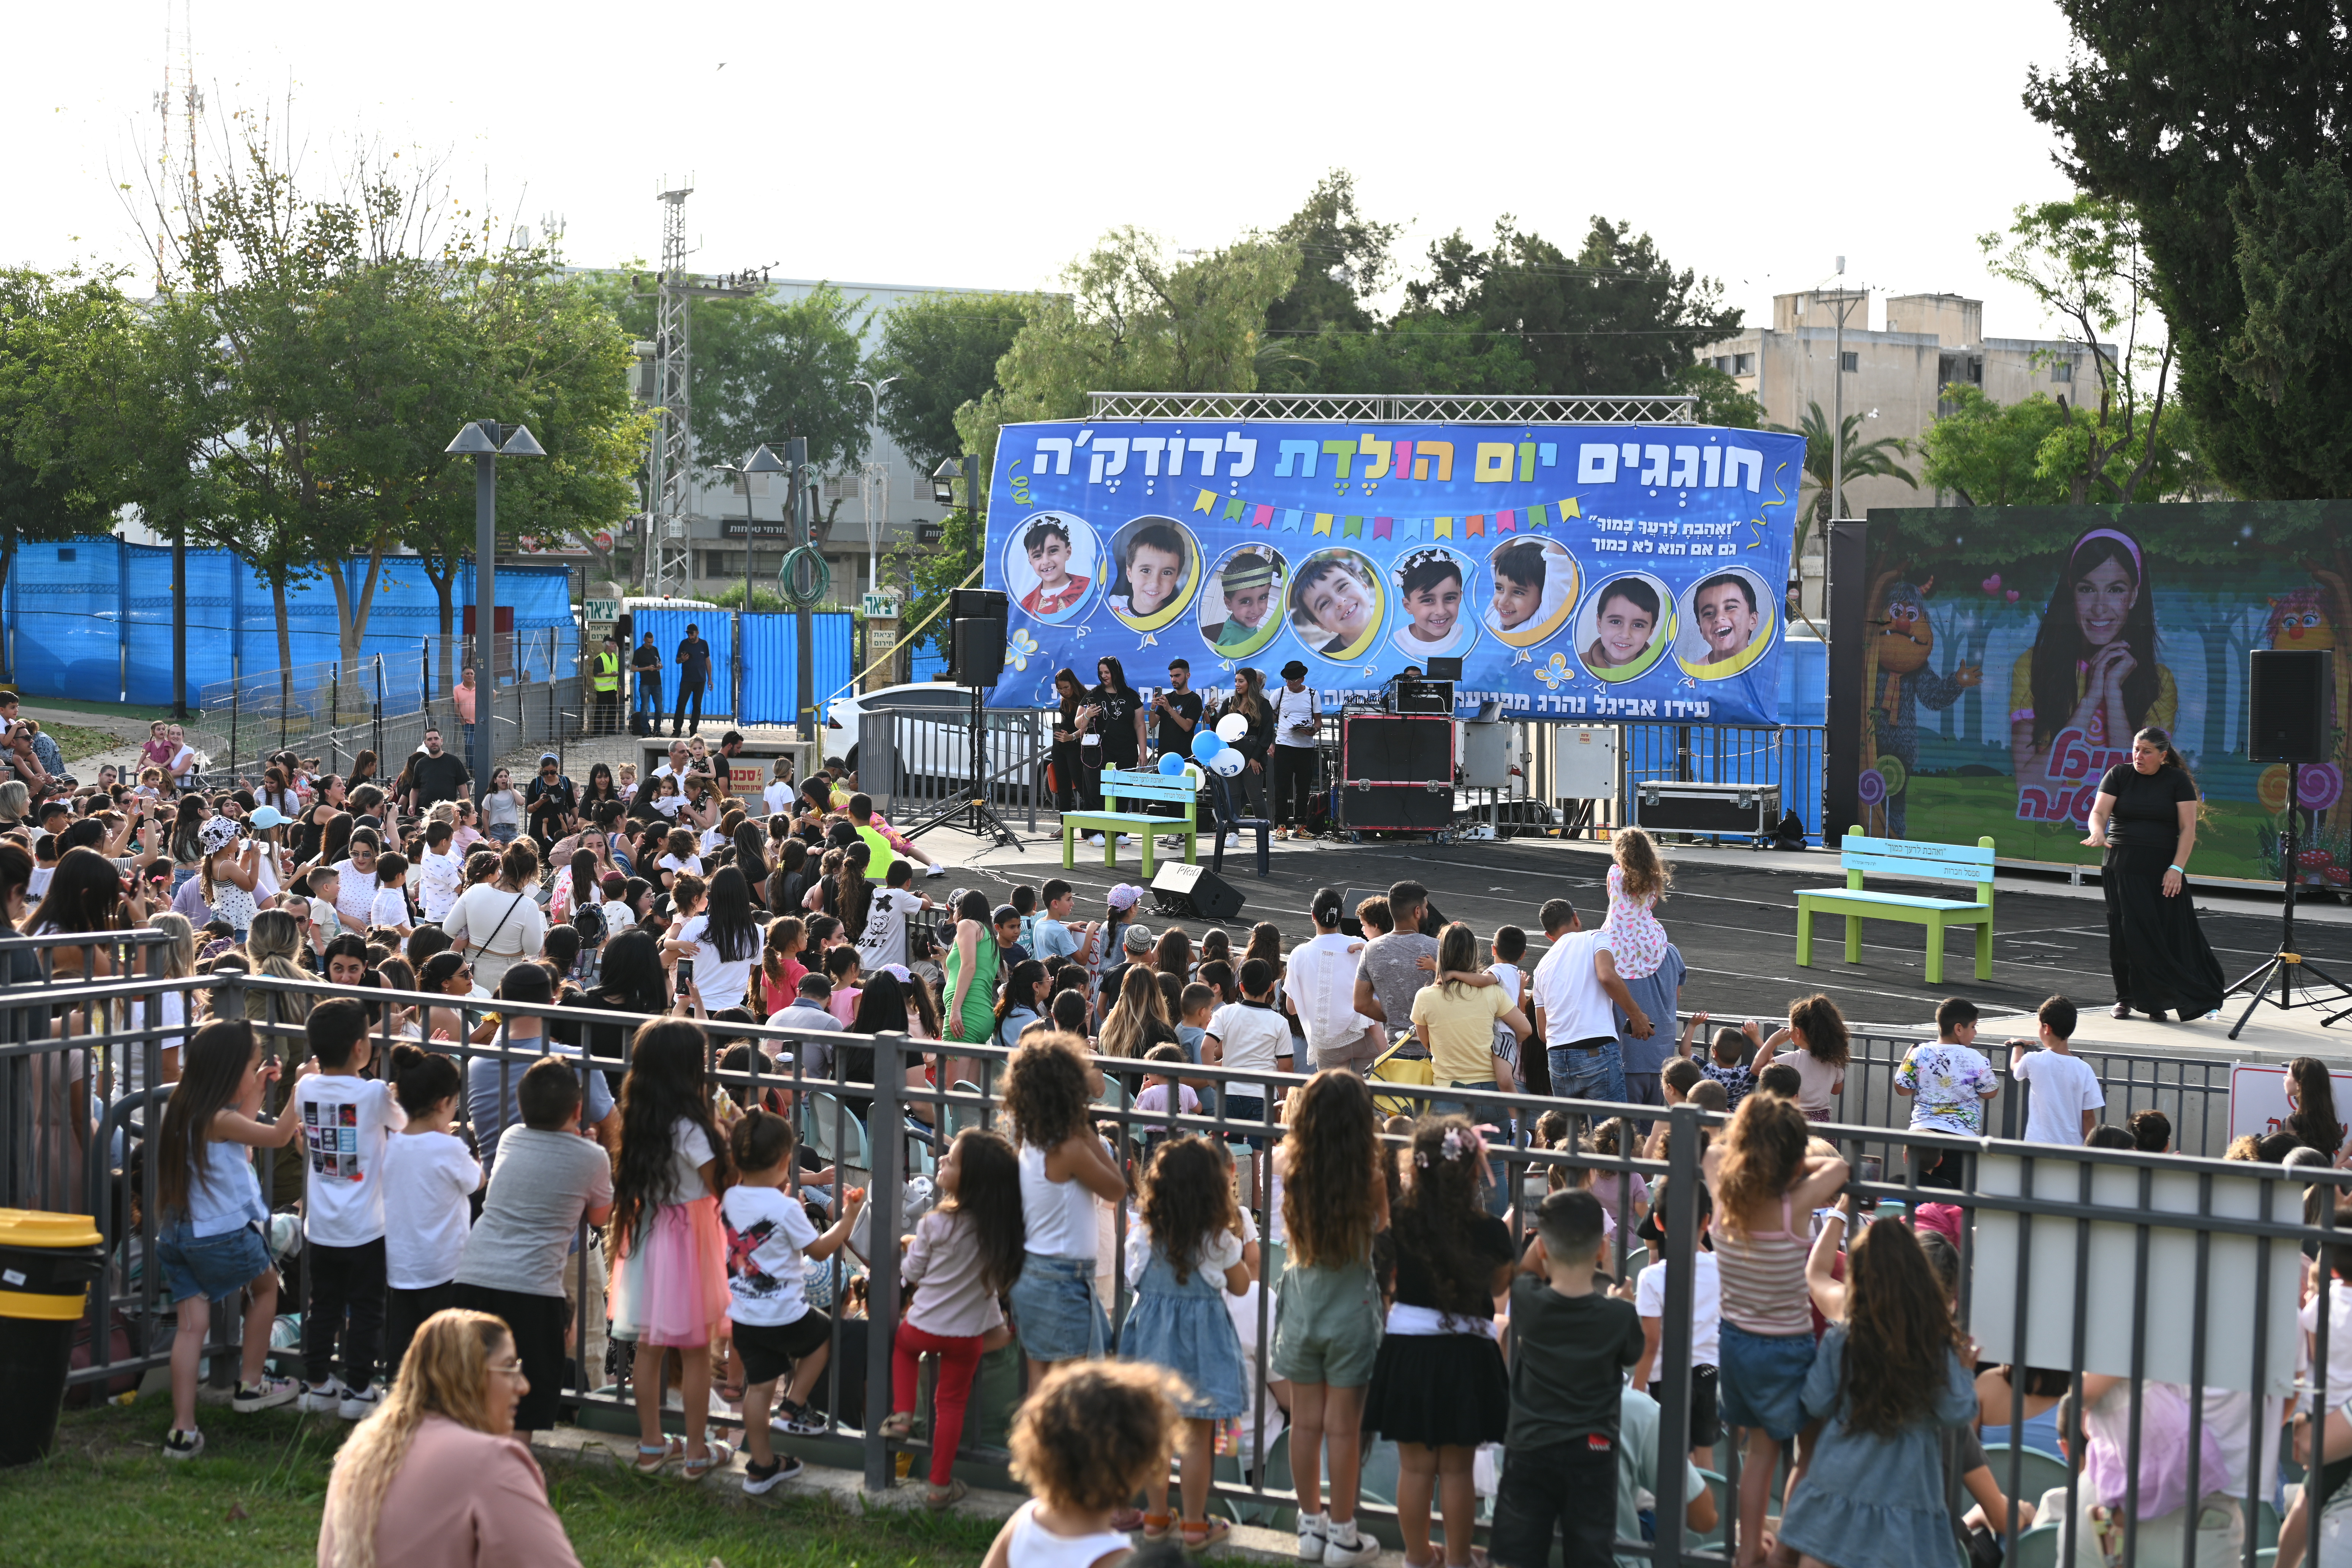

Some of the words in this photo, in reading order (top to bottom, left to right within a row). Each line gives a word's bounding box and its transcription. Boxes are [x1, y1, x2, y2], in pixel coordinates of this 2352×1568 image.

[1591, 538, 1628, 552] כמוך
[1632, 540, 1653, 553] לא
[1658, 542, 1686, 555] הוא
[1690, 544, 1713, 556] אם
[1718, 544, 1737, 556] גם
[586, 601, 616, 619] יציאה
[1537, 695, 1587, 713] נהרג
[1593, 694, 1657, 717] אביגל
[1664, 700, 1710, 718] עידו
[1885, 842, 1903, 853] כמוך"
[1904, 844, 1921, 855] לרעך
[1964, 867, 1980, 877] ספסל
